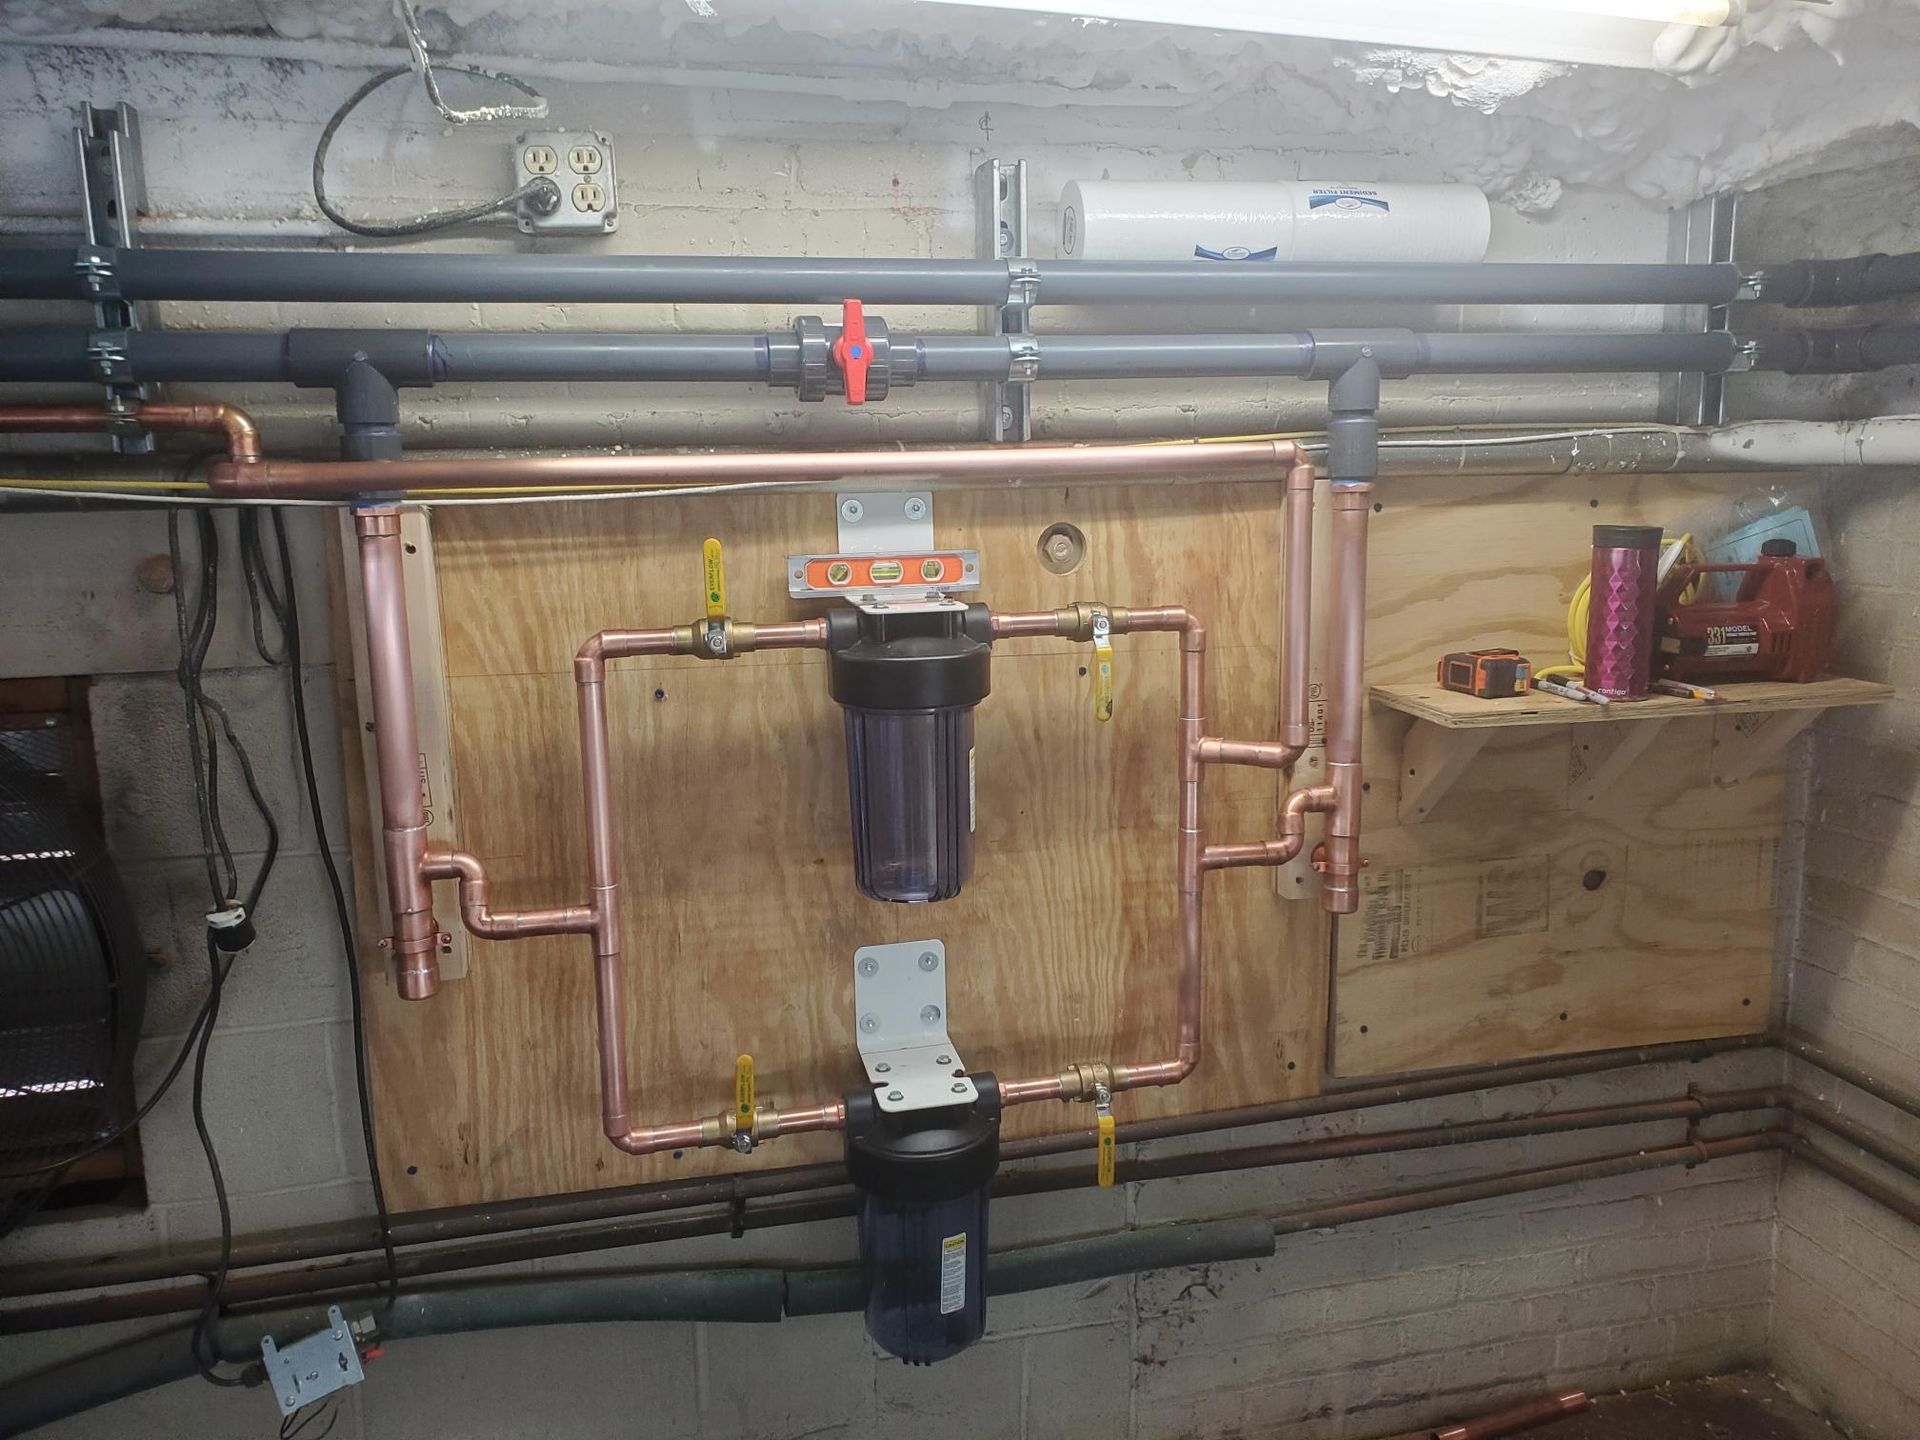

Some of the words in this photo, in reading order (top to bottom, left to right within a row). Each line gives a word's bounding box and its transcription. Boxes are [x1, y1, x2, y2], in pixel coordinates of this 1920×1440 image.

[1707, 626, 1726, 645] 331
[1725, 625, 1753, 633] MODEL
[1597, 687, 1626, 696] contigo
